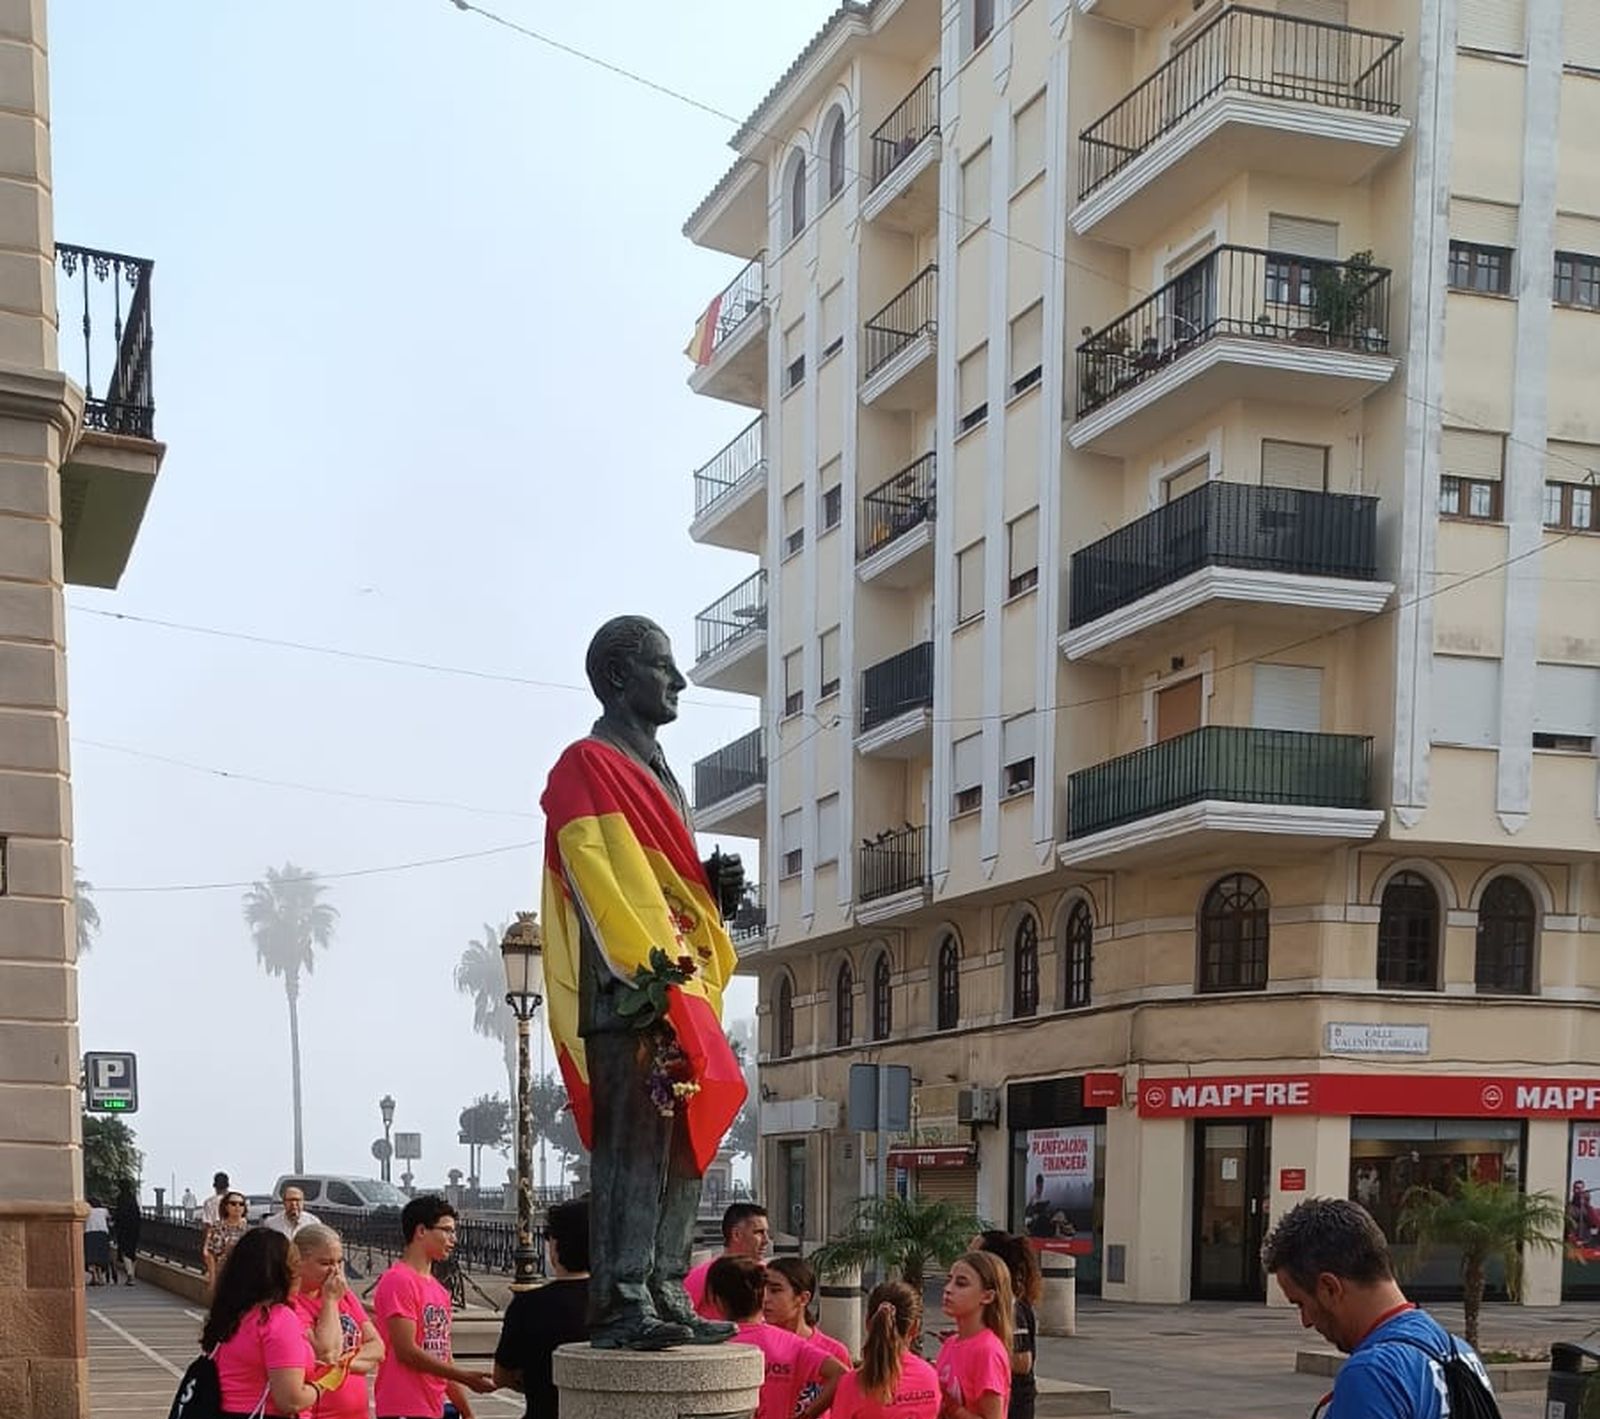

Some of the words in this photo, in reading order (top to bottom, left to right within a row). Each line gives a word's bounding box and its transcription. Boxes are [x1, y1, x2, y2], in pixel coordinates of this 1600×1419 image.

[98, 1060, 125, 1088] P
[1170, 1082, 1310, 1108] MAPFRE
[1577, 1138, 1597, 1158] DE
